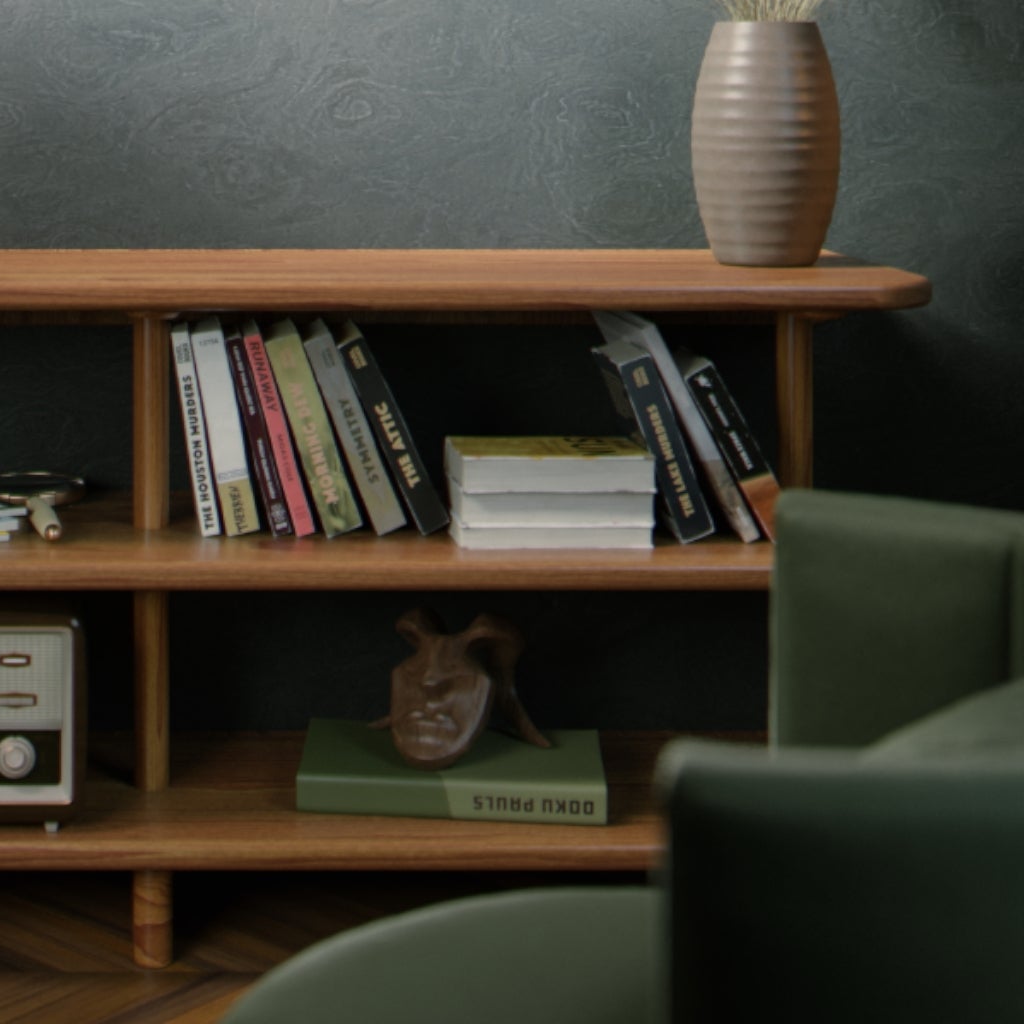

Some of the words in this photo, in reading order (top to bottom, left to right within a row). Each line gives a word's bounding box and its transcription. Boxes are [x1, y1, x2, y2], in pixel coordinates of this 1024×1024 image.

[248, 341, 278, 412] RUNAWAY
[290, 381, 310, 419] DEW
[182, 375, 201, 435] MURDERS
[374, 401, 406, 450] ATTIC
[303, 421, 339, 505] MORNING
[338, 398, 379, 484] SYMMETRY
[192, 440, 210, 501] HOUSTON
[397, 451, 421, 489] THE
[202, 503, 214, 530] THE
[472, 795, 534, 813] PAULS
[541, 796, 594, 815] DOKU
